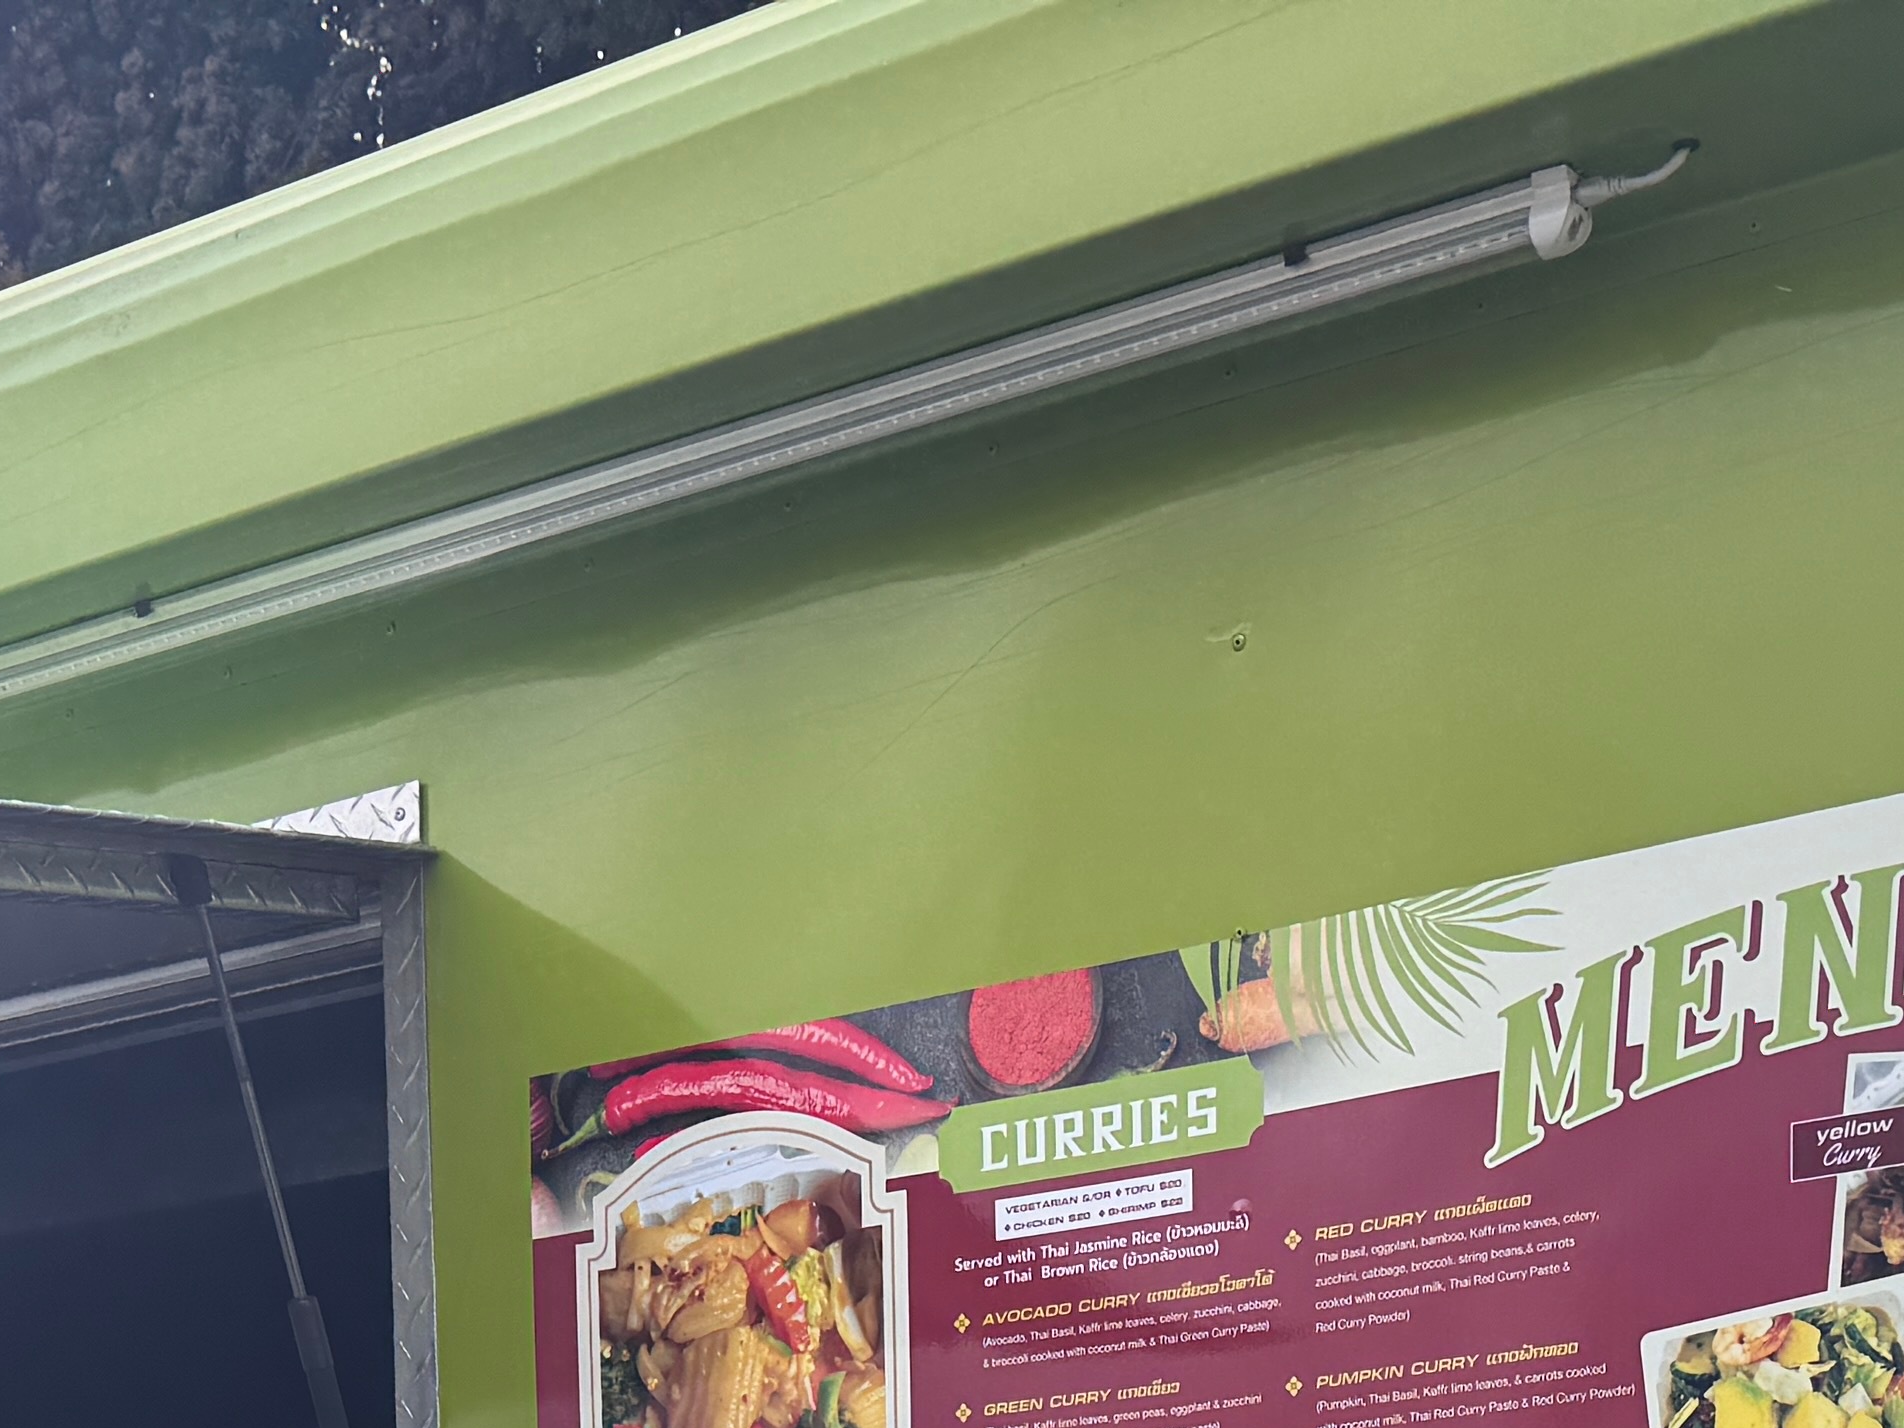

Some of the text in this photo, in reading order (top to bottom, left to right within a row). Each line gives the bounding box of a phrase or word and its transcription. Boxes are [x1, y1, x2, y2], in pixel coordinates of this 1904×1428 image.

[979, 1085, 1220, 1173] CURRIES
[1816, 1116, 1894, 1147] yellow
[1822, 1141, 1882, 1170] Curry
[1315, 1210, 1427, 1241] RED CURRY
[954, 1257, 1002, 1273] Served
[1007, 1249, 1036, 1266] with
[1041, 1244, 1069, 1259] Thai
[1073, 1236, 1128, 1255] Jasmine
[1132, 1231, 1162, 1245] Rice
[984, 1276, 999, 1288] or
[1004, 1268, 1032, 1284] Thai
[1041, 1262, 1085, 1279] Brown
[1089, 1257, 1118, 1272] Rice
[983, 1293, 1141, 1326] AVOCADO CURRY
[1316, 1354, 1479, 1389] PUMPKIN CURRY
[984, 1388, 1111, 1417] GREEN CURRY
